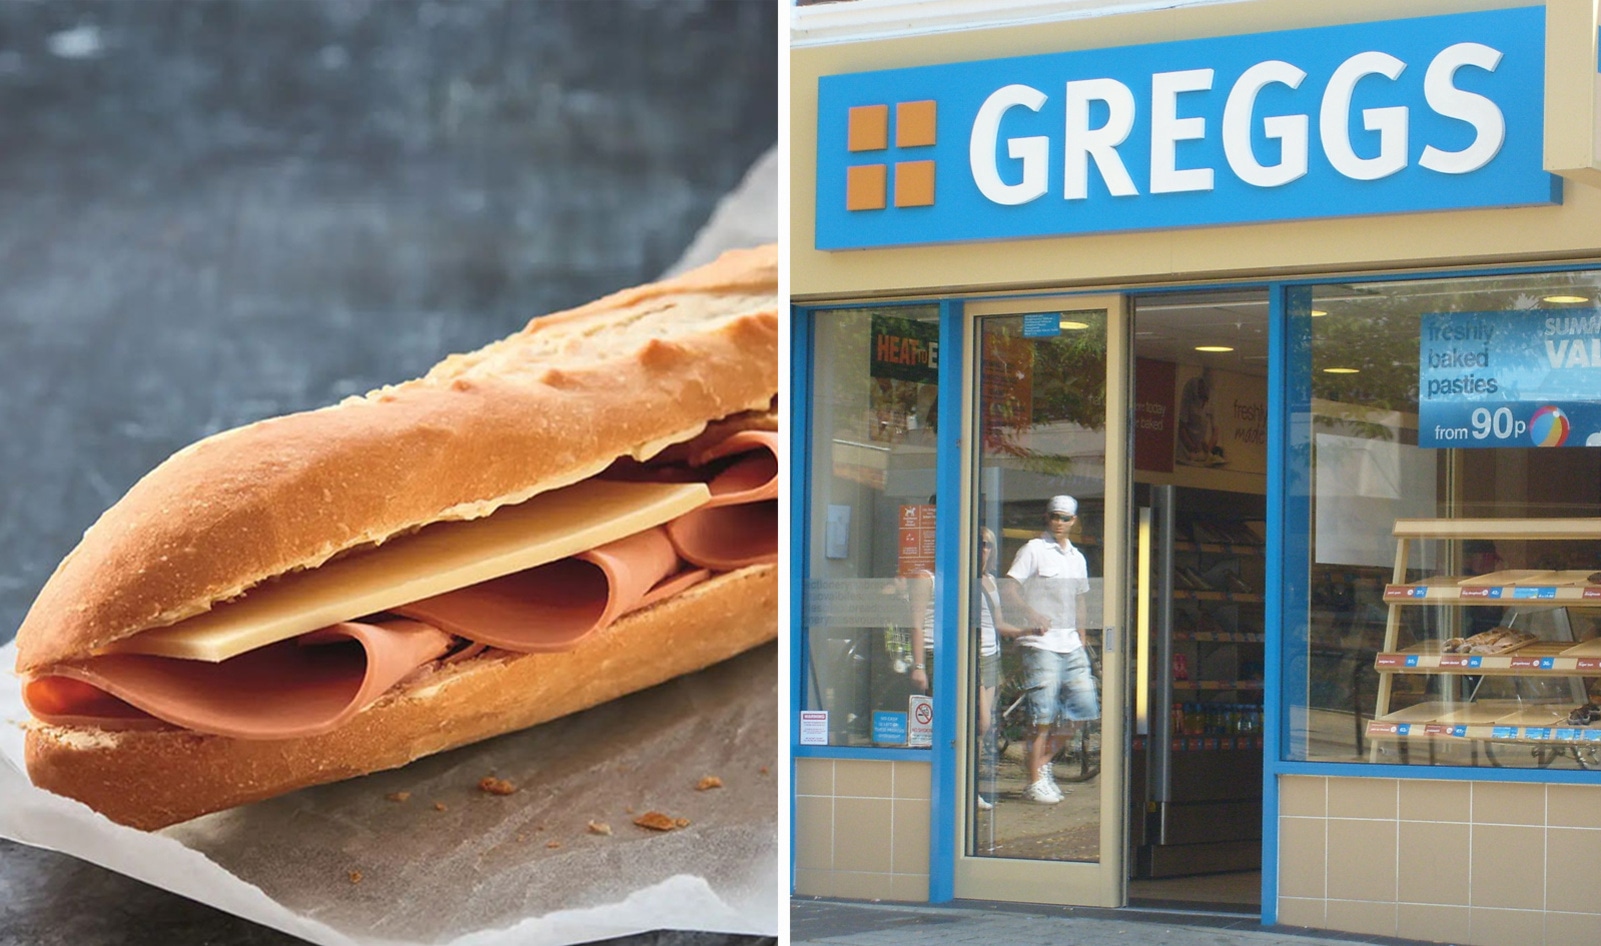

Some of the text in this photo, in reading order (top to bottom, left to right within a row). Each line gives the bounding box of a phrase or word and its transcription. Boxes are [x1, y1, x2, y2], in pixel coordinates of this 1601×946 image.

[969, 42, 1506, 206] GREGGS
[1428, 319, 1494, 347] freshly
[878, 334, 919, 366] HEAT
[916, 349, 928, 364] TO
[1428, 348, 1489, 368] baked
[1427, 374, 1498, 399] pasties
[1435, 424, 1468, 440] from
